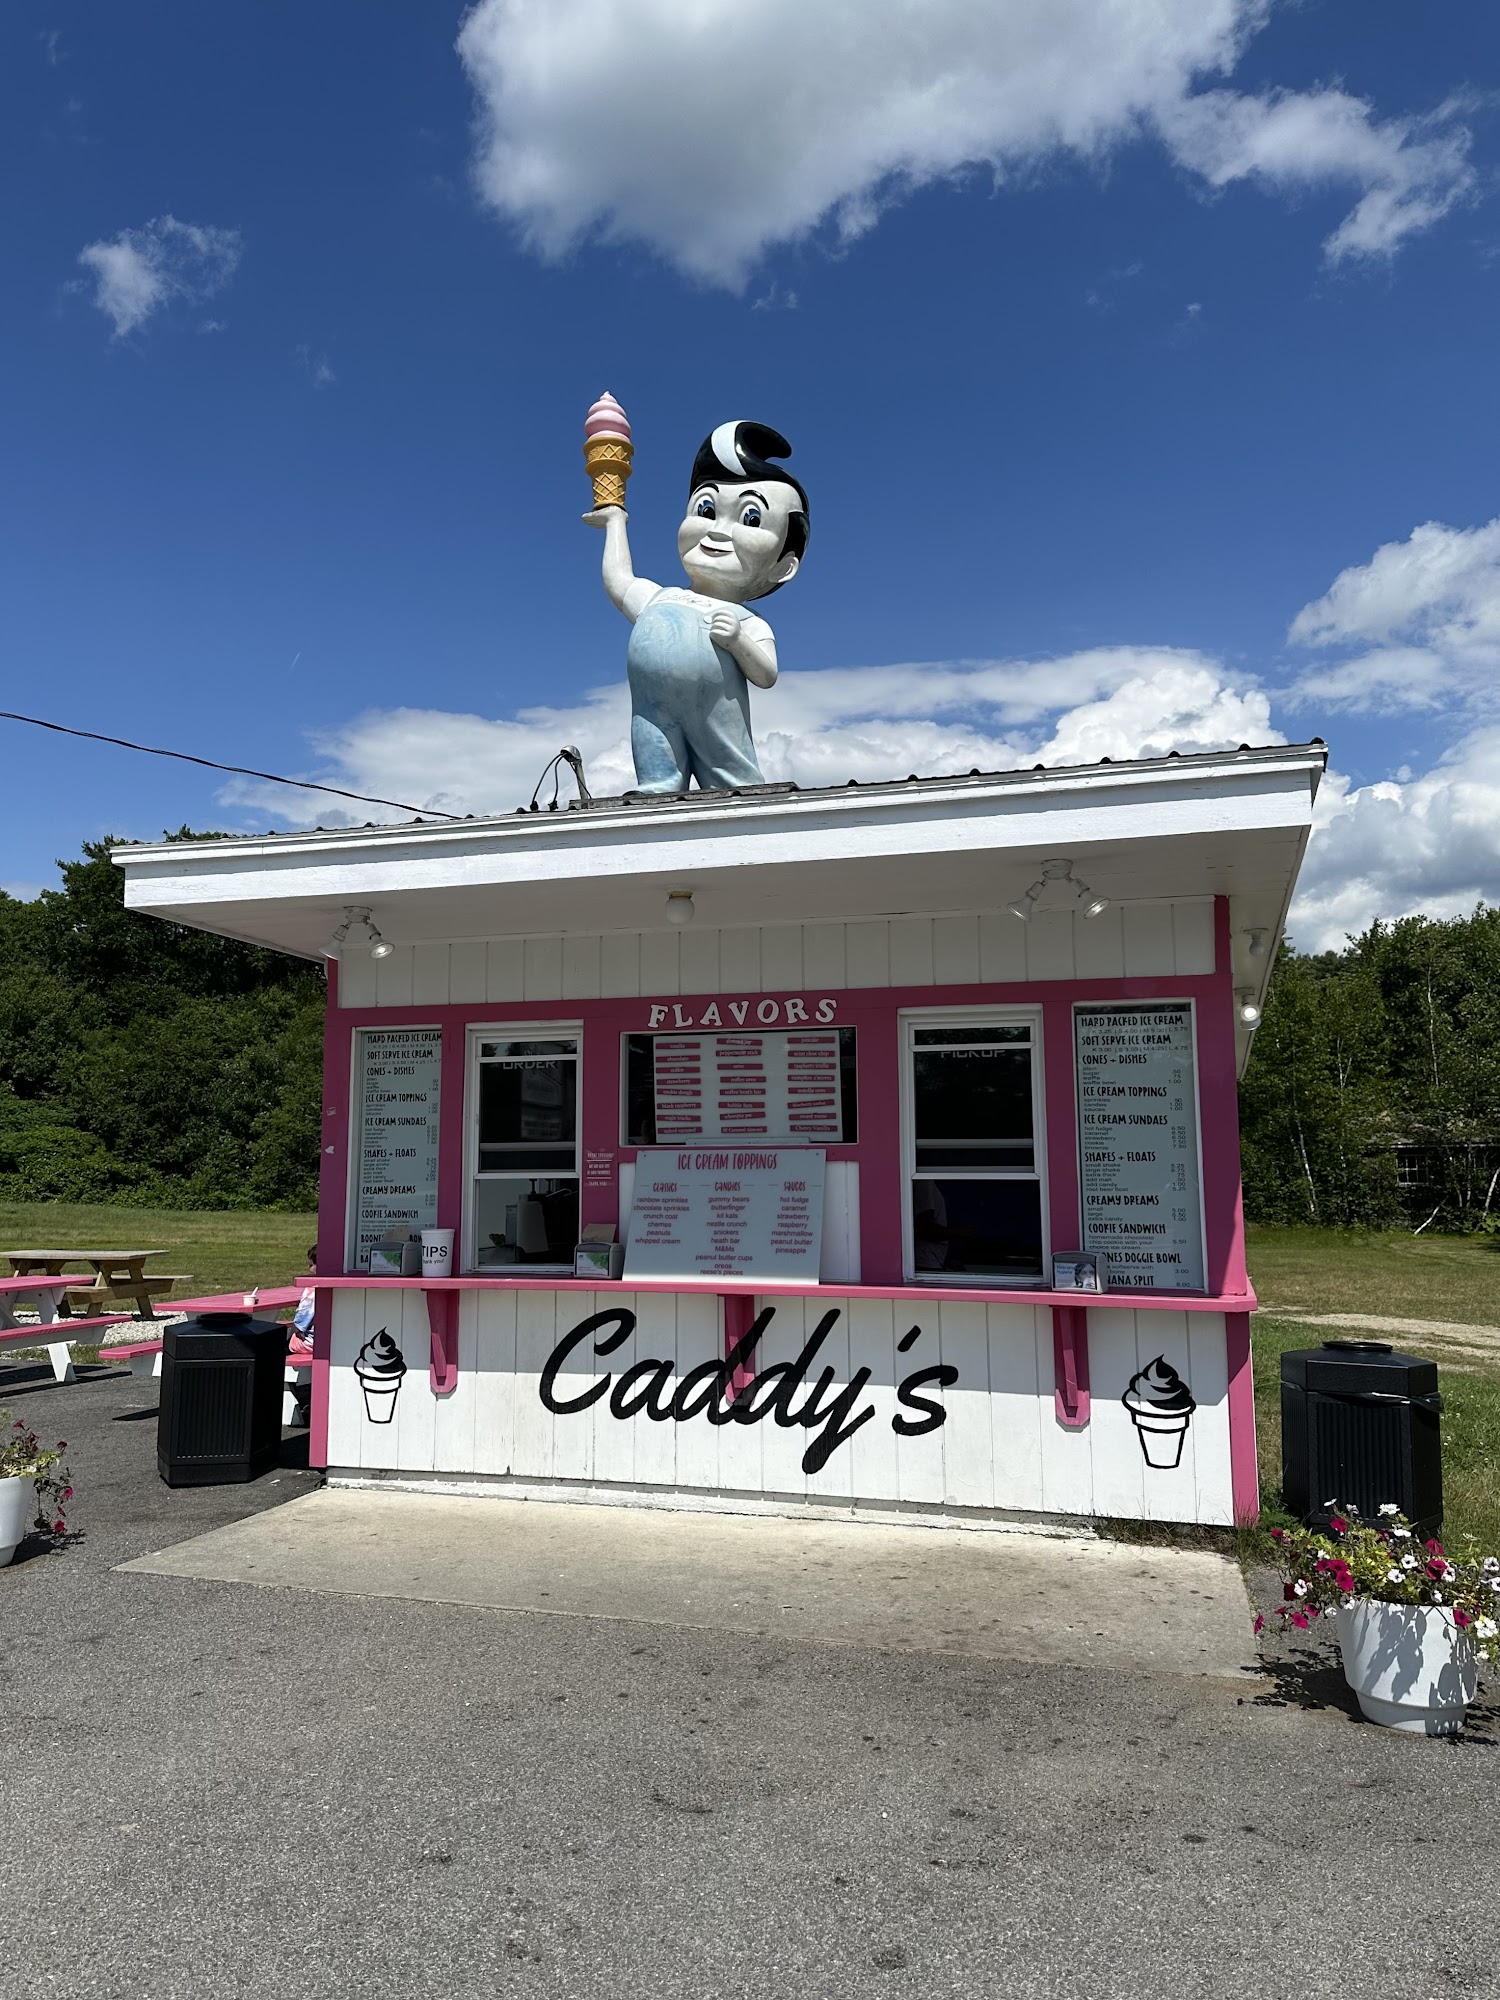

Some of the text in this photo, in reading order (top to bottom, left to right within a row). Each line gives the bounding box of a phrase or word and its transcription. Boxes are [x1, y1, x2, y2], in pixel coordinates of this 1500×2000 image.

[647, 998, 838, 1028] FLAVORS
[1081, 1014, 1184, 1027] HARD PACKED ICE CREAM
[367, 1032, 443, 1044] HARD PACKED ICE CREAM
[1081, 1034, 1172, 1046] SOFT SERVE ICE CREAM
[367, 1049, 434, 1060] SOFT SERVE ICE CREAM
[1082, 1054, 1108, 1065] CONES
[1119, 1053, 1147, 1065] DISHES
[366, 1066, 386, 1076] CONES
[393, 1066, 415, 1076] DISHES
[365, 1092, 428, 1104] ICE CREAM TOPPINGS
[1083, 1086, 1167, 1098] ICE CREAM TOPPINGS
[364, 1116, 427, 1127] ICE CREAM SUNDAES
[1084, 1114, 1168, 1126] ICE CREAM SUNDAES
[363, 1148, 387, 1159] SHAKES
[394, 1148, 417, 1158] FLOATS
[1084, 1151, 1116, 1162] SHAKES
[1126, 1151, 1156, 1162] FLOATS
[677, 1153, 778, 1171] ICE CREAM TOPPINGS
[362, 1185, 416, 1195] CREAMY DREAMS
[1086, 1194, 1160, 1206] CREAMY DREAMS
[361, 1209, 419, 1219] COOKIE SANDWICH
[1088, 1223, 1166, 1235] COOKIE SANDWICH
[421, 1245, 448, 1258] TIPS
[1125, 1252, 1154, 1264] DOGGIE
[1156, 1252, 1182, 1264] BOWL
[1133, 1275, 1155, 1287] SPLIT
[539, 1306, 959, 1474] Caddy's
